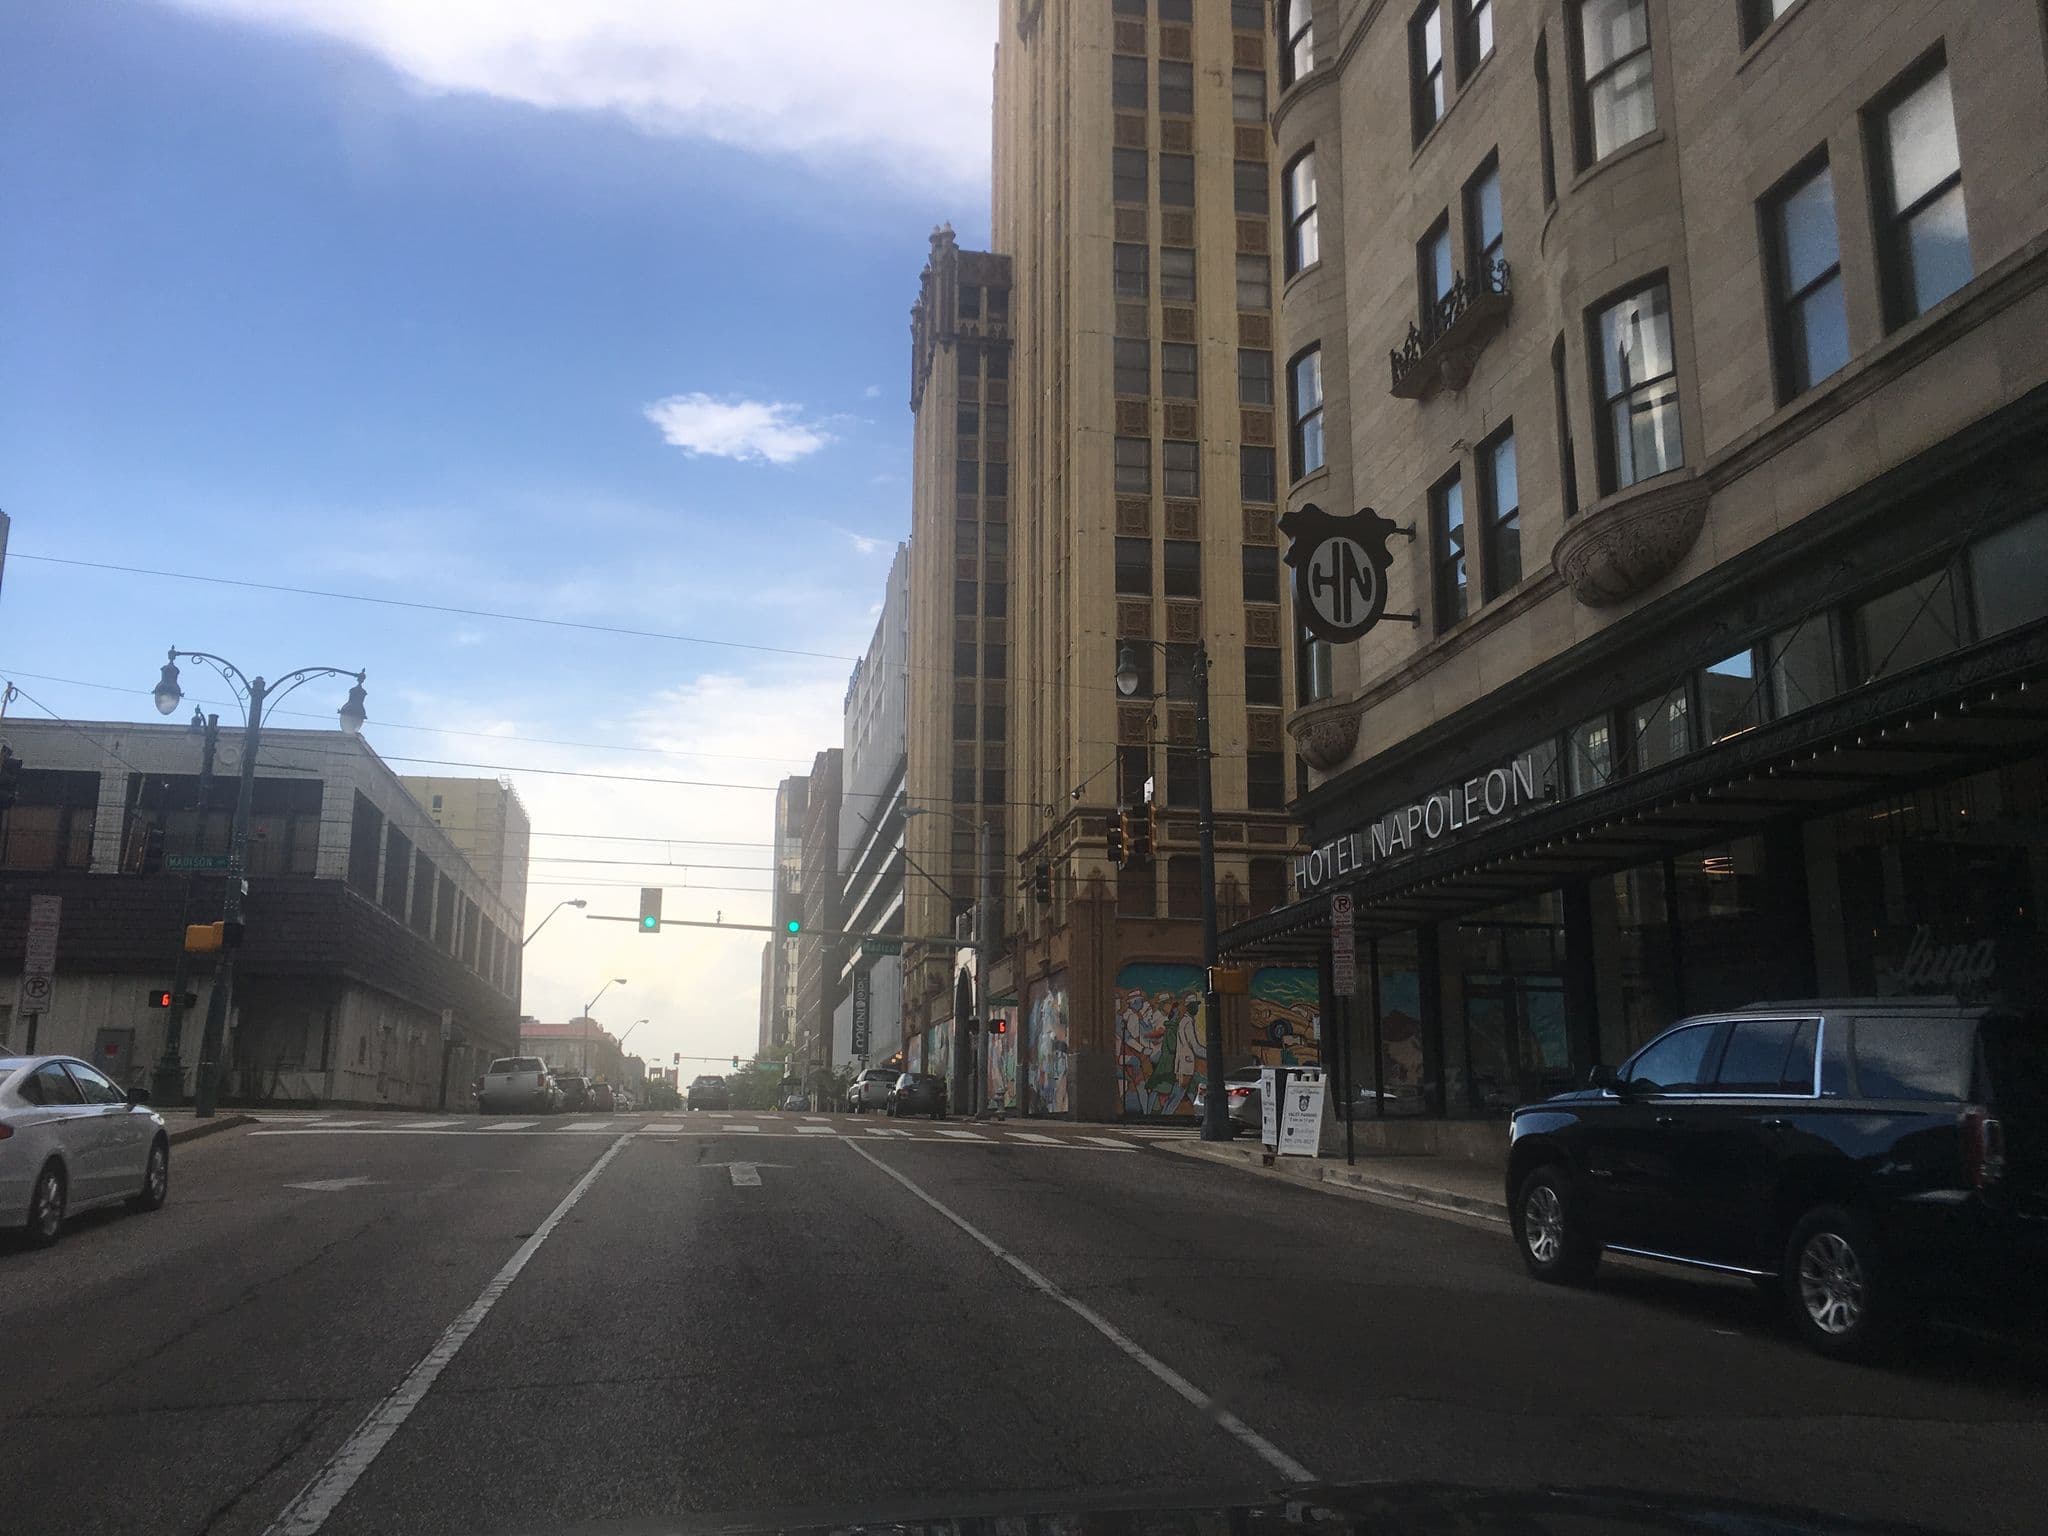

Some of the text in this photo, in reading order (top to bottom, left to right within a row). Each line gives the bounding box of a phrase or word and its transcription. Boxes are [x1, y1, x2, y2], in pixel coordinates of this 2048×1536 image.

[1312, 541, 1372, 624] HN
[1294, 754, 1534, 892] HOTEL NAPOLEON
[168, 856, 213, 867] MADISON
[162, 994, 169, 1006] 6
[855, 1008, 866, 1048] INDIGO
